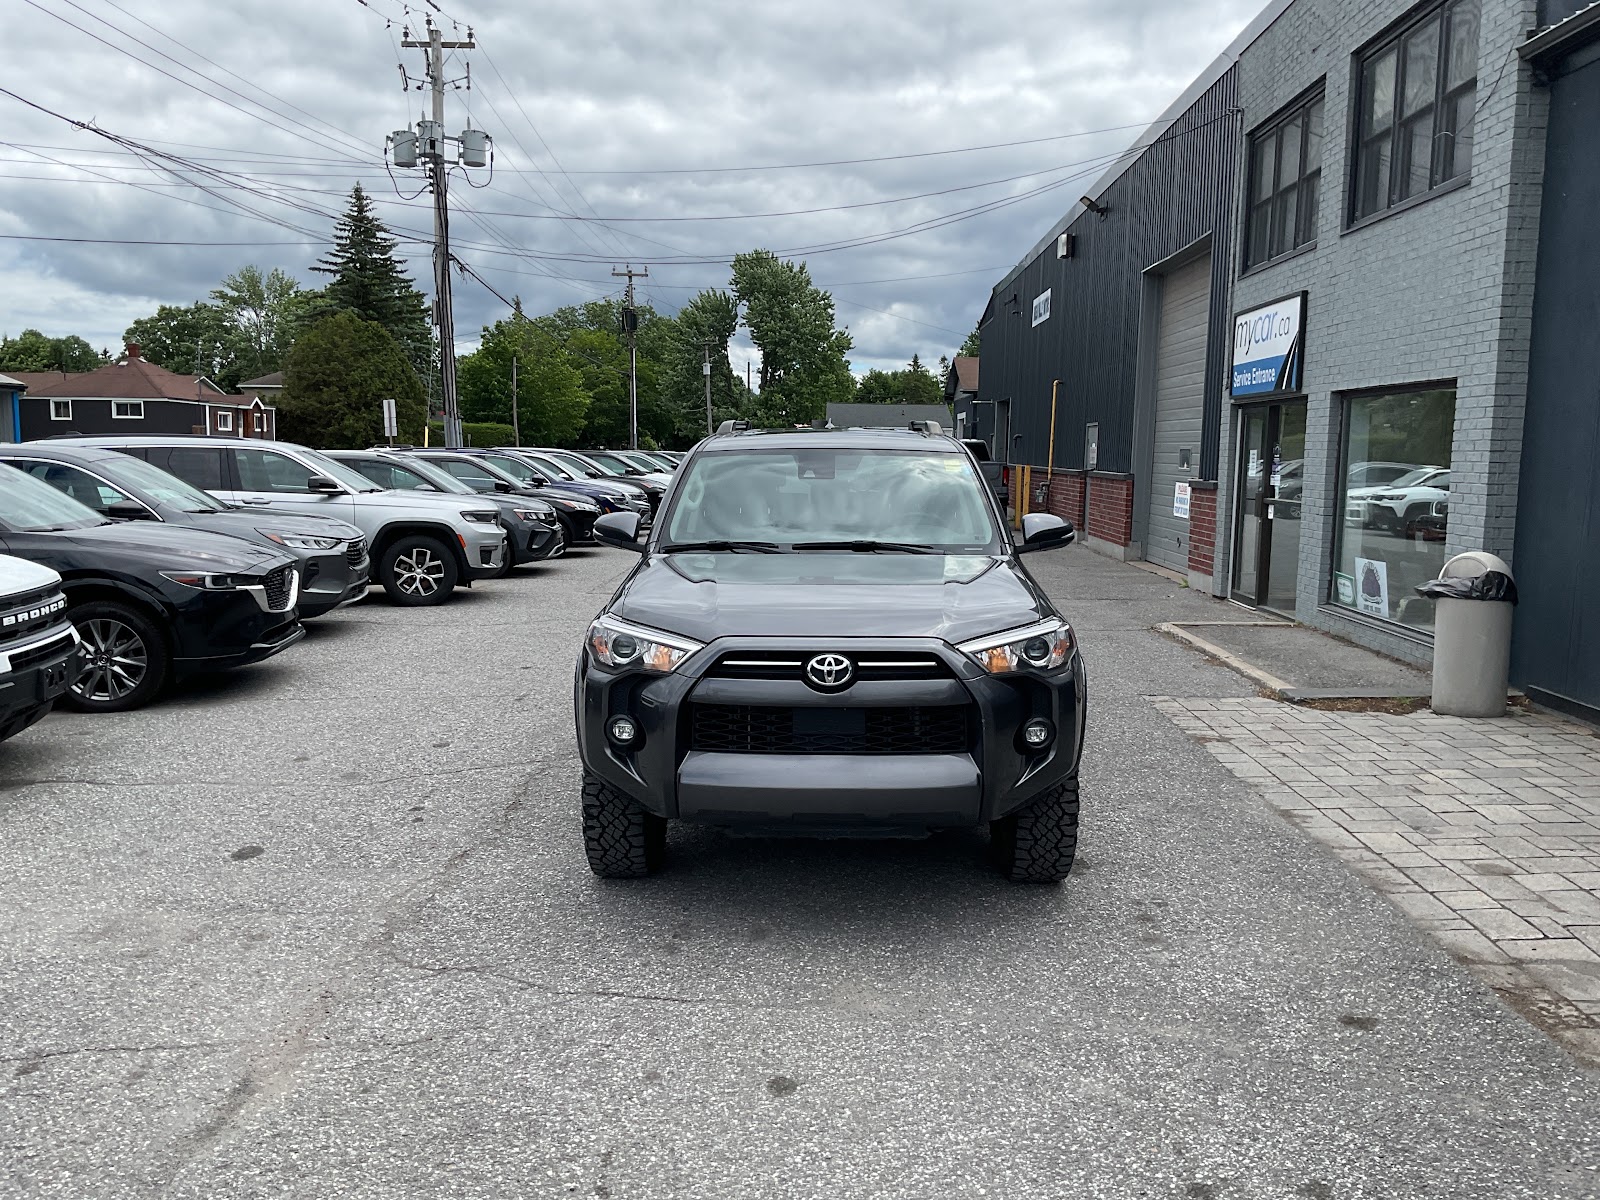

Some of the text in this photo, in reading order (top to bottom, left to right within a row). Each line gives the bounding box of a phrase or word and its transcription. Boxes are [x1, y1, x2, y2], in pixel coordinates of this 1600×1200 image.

[1233, 367, 1276, 388] Service Entrance
[2, 599, 65, 627] BRONCO
